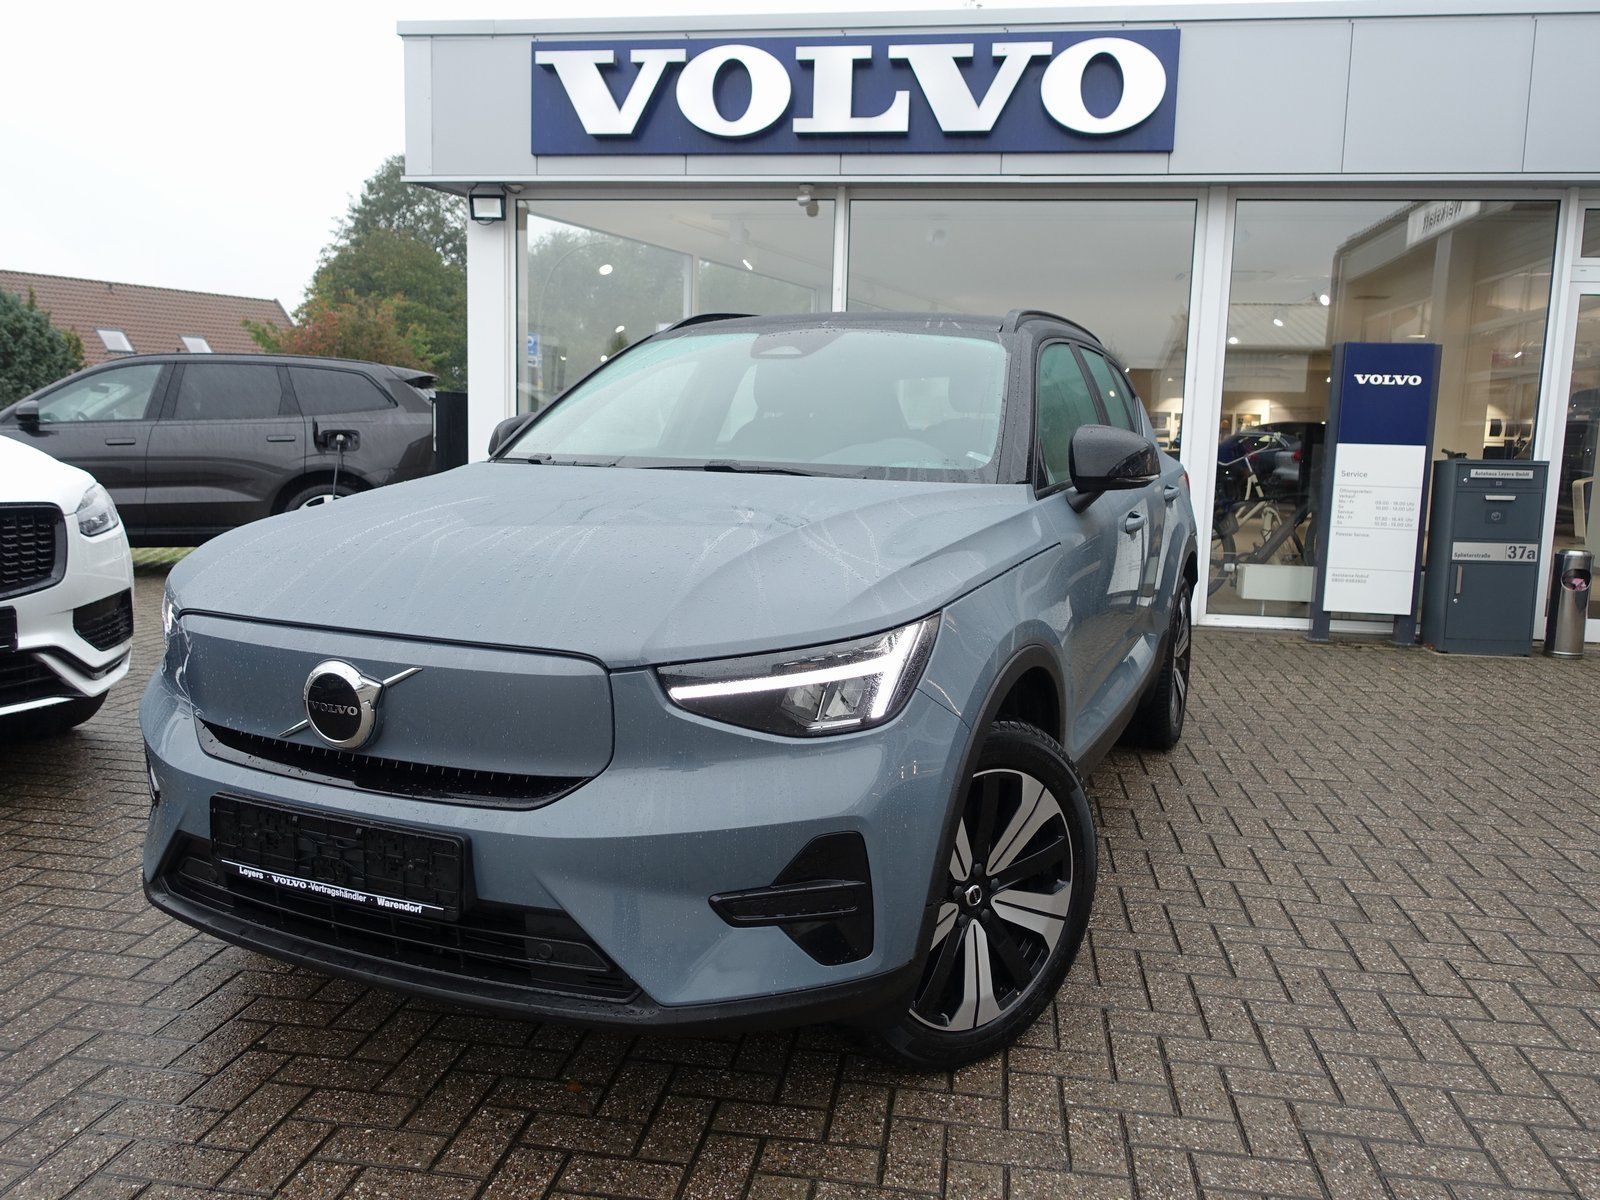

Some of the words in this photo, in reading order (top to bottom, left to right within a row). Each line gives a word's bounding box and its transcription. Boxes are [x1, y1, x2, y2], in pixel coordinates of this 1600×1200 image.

[535, 37, 1167, 137] VOLVO
[1354, 374, 1422, 386] VOLVO
[1341, 470, 1368, 478] Service
[1507, 545, 1536, 560] 37a
[309, 700, 358, 716] VOLVO
[239, 866, 264, 880] Leyers
[377, 896, 422, 914] Warendorf
